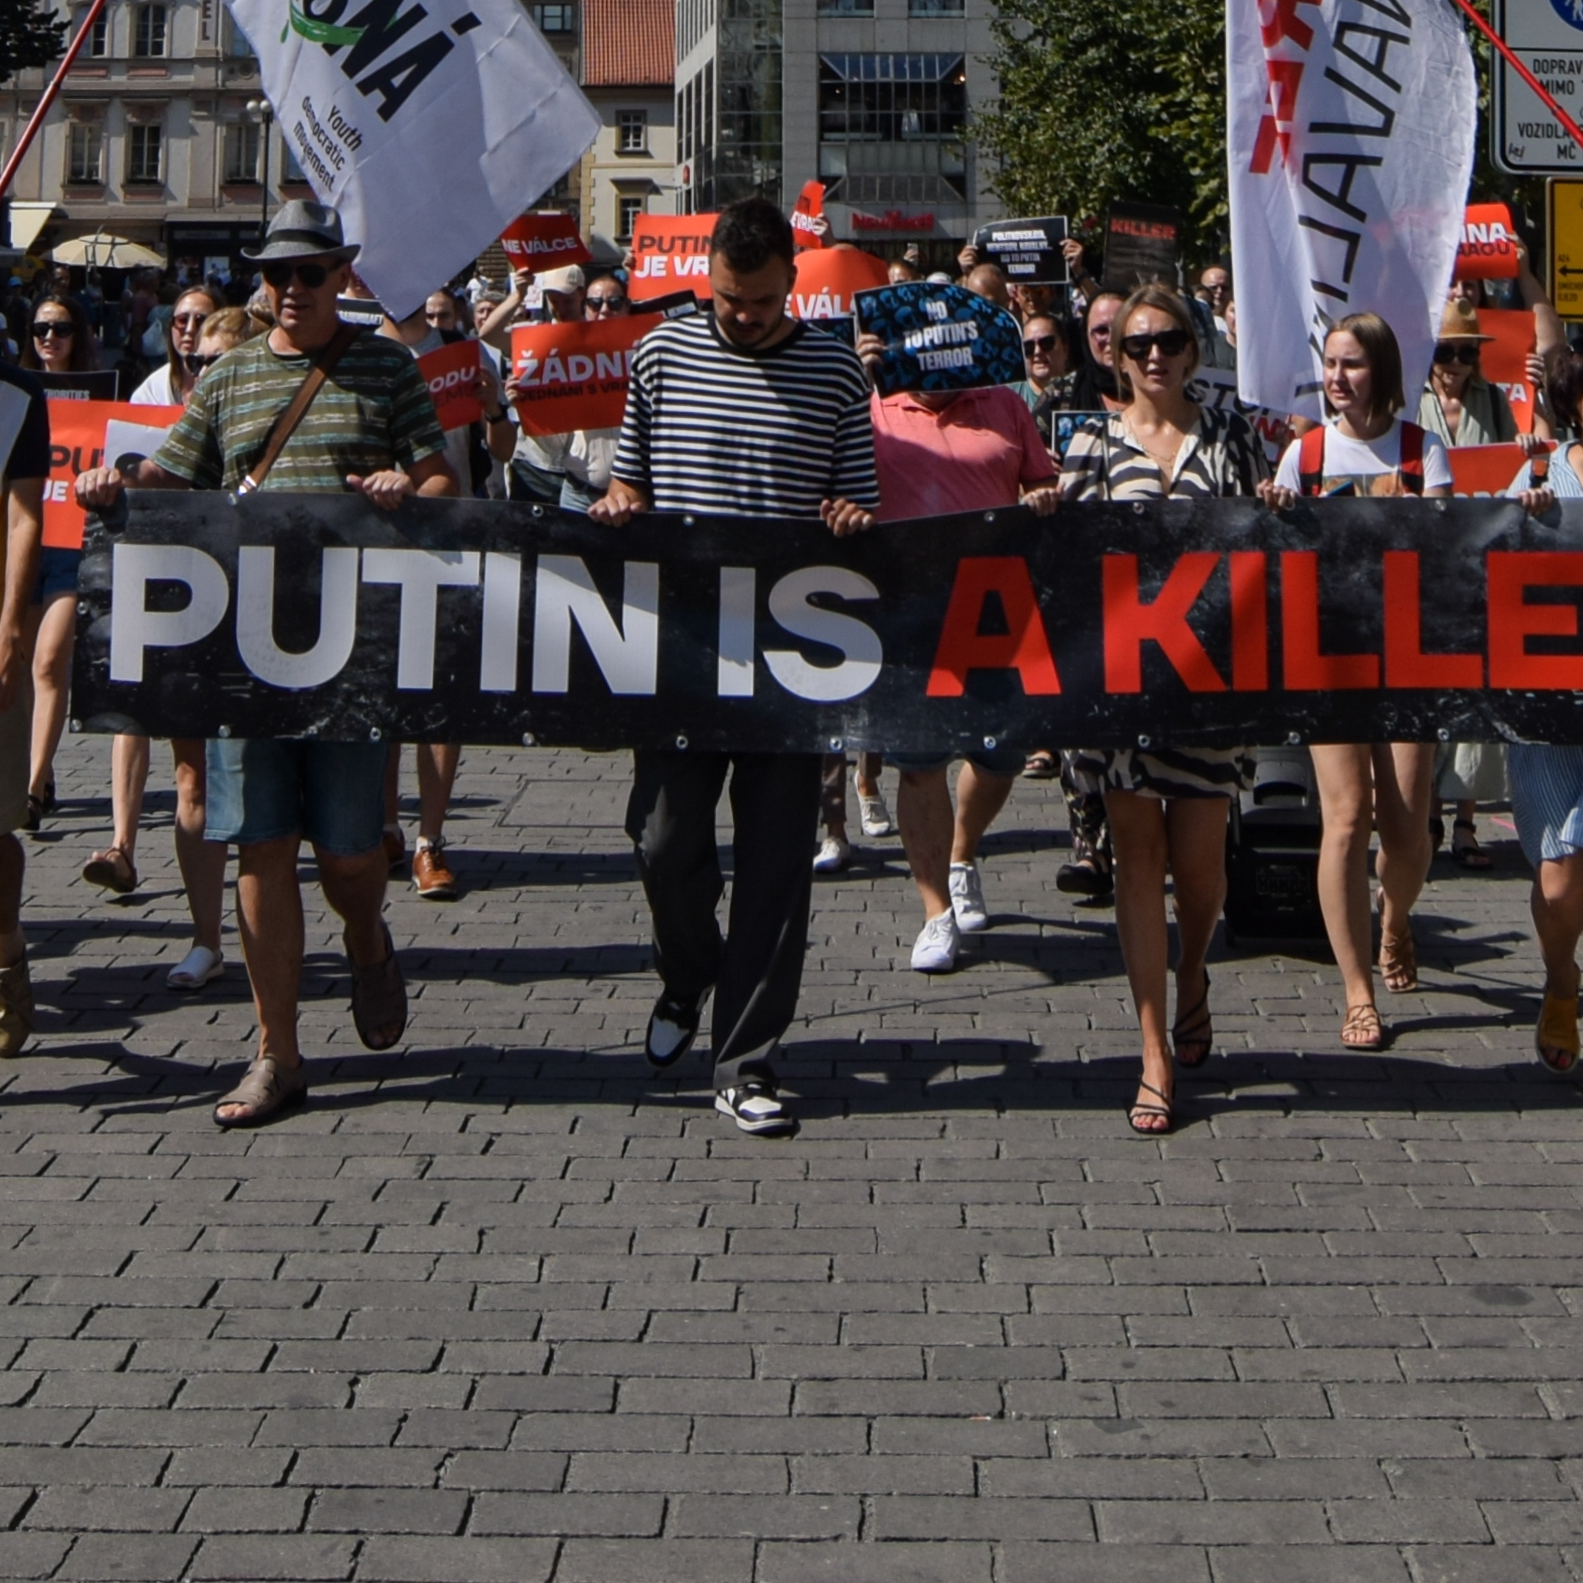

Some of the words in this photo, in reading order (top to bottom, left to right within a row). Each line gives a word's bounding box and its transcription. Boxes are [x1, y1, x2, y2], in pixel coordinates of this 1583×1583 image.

[1539, 79, 1575, 95] MIMO
[301, 96, 345, 171] democratic
[327, 104, 363, 152] Youth
[293, 120, 336, 193] movement
[1557, 142, 1576, 160] MČ
[1110, 218, 1177, 241] KILLER
[501, 239, 522, 255] NE
[522, 236, 578, 255] VÁLCE
[634, 255, 667, 278] JE
[925, 301, 948, 321] NO
[903, 329, 923, 348] TO
[923, 320, 979, 347] PUTIN'S
[917, 347, 975, 371] TERROR
[109, 543, 659, 697] PUTIN
[717, 565, 883, 703] IS
[925, 555, 1062, 698] A
